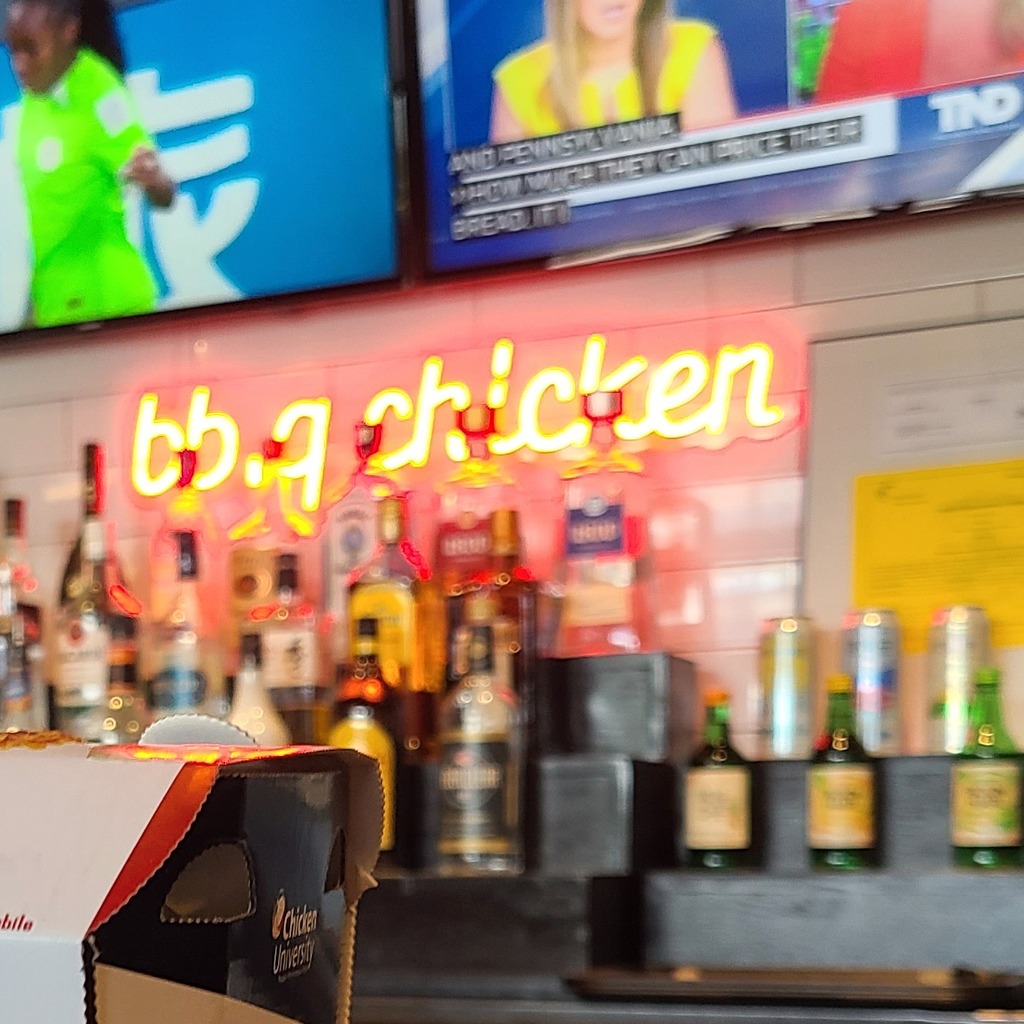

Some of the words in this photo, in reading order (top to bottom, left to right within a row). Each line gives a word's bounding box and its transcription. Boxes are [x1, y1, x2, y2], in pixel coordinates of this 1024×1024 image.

[132, 386, 334, 511] bb.q
[366, 334, 784, 470] chicken
[283, 904, 318, 941] Chicken
[273, 935, 316, 976] University
